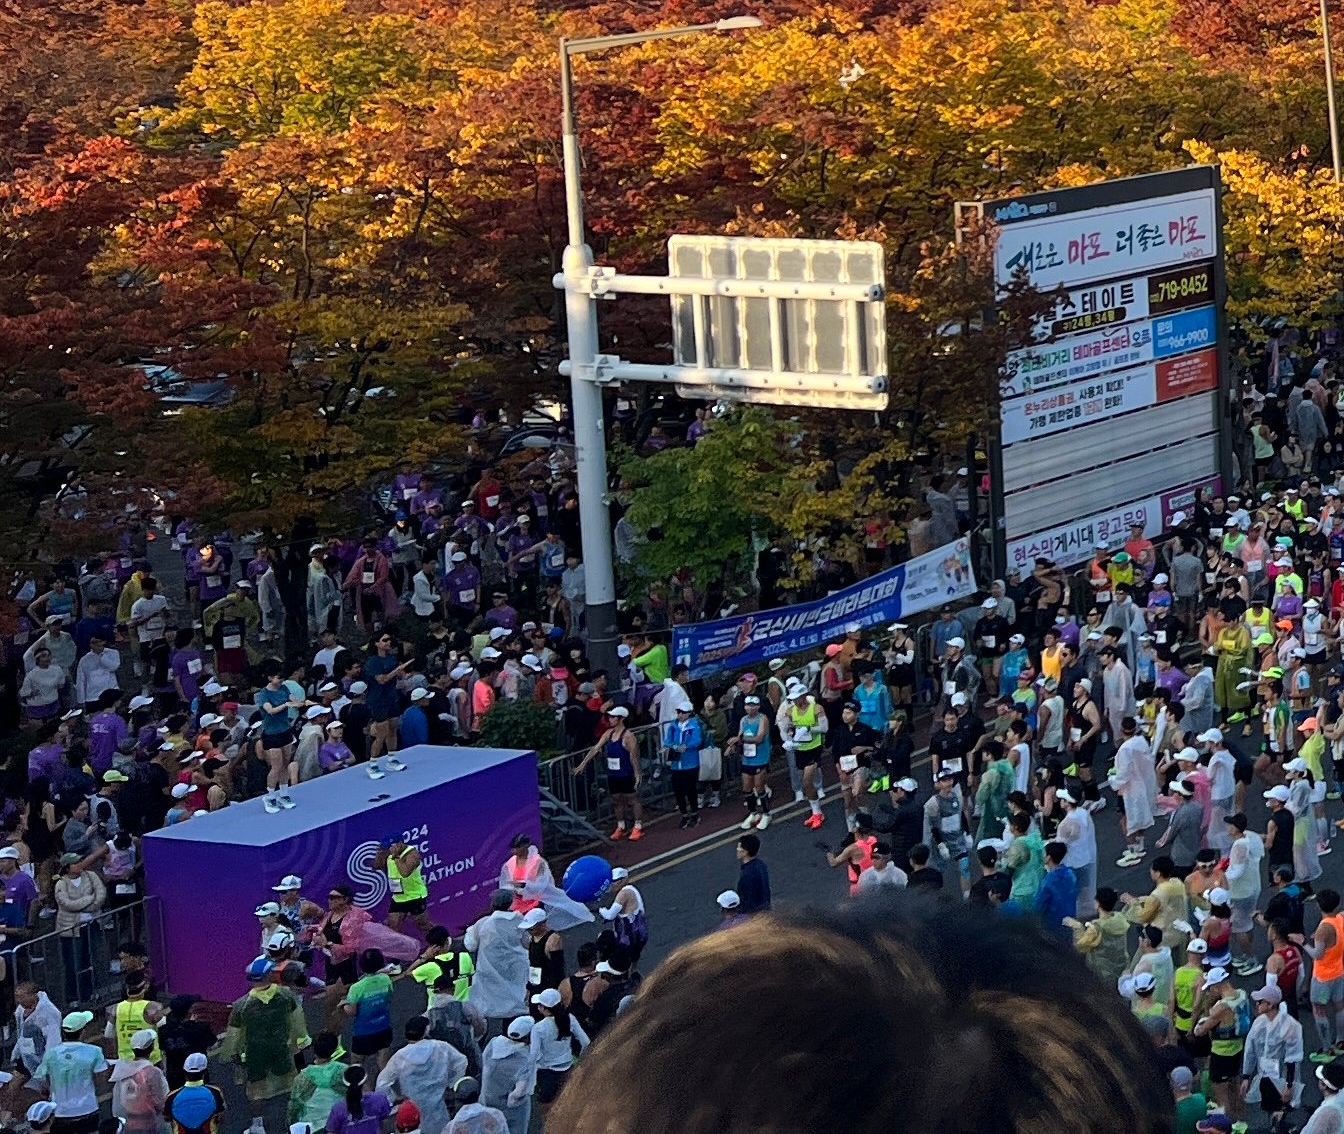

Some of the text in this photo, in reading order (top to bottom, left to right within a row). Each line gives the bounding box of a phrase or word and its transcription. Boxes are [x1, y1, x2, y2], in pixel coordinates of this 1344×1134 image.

[1005, 242, 1064, 274] 새로운
[1068, 232, 1110, 265] 마포
[1137, 223, 1165, 252] 좋은
[1168, 215, 1206, 246] 마포
[1044, 282, 1135, 321] 스테이트
[402, 823, 429, 844] 024
